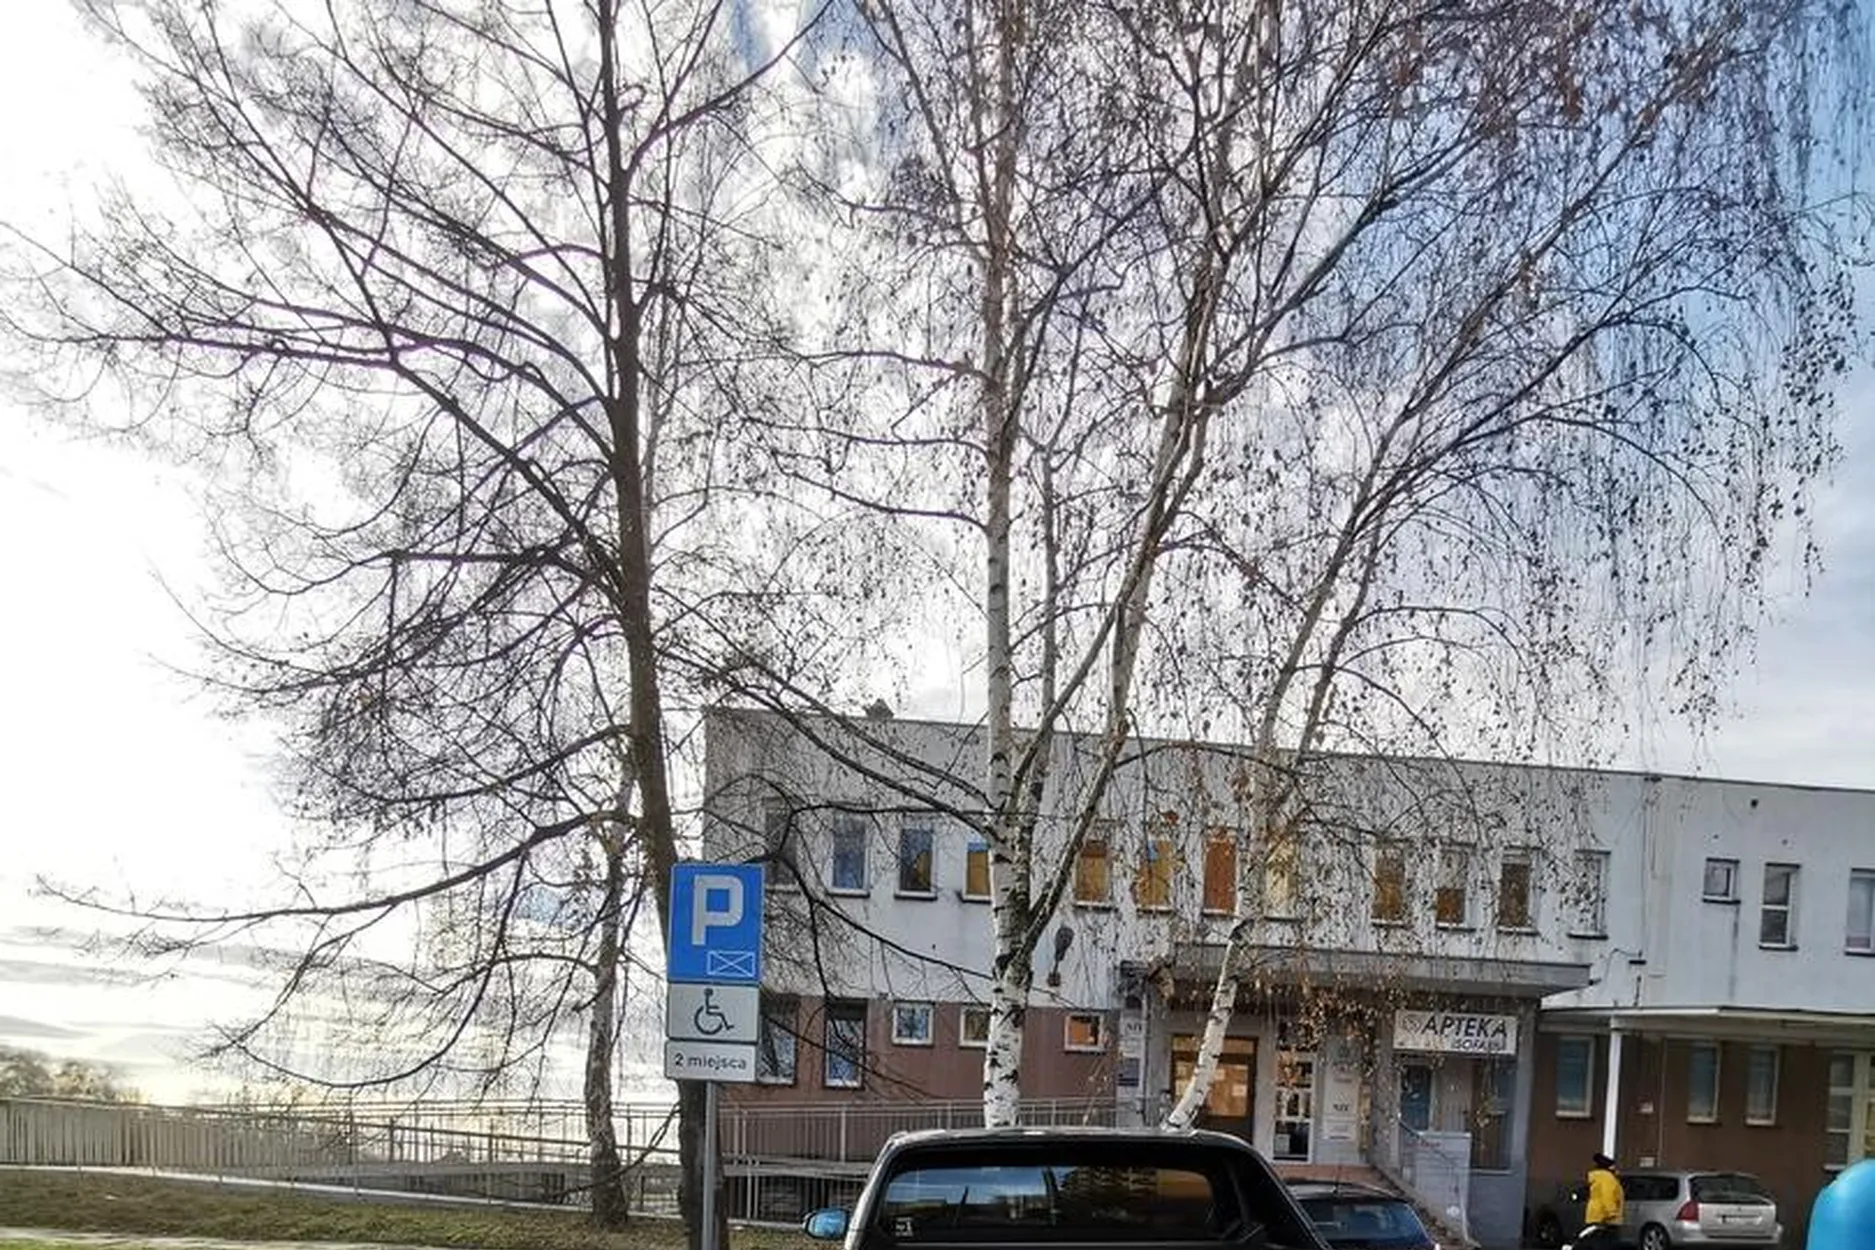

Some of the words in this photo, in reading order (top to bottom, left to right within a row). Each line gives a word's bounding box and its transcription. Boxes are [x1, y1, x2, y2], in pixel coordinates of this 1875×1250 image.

[692, 874, 743, 946] P
[1421, 1015, 1508, 1038] APTEKA
[675, 1052, 684, 1067] 2
[688, 1054, 747, 1071] miejsca
